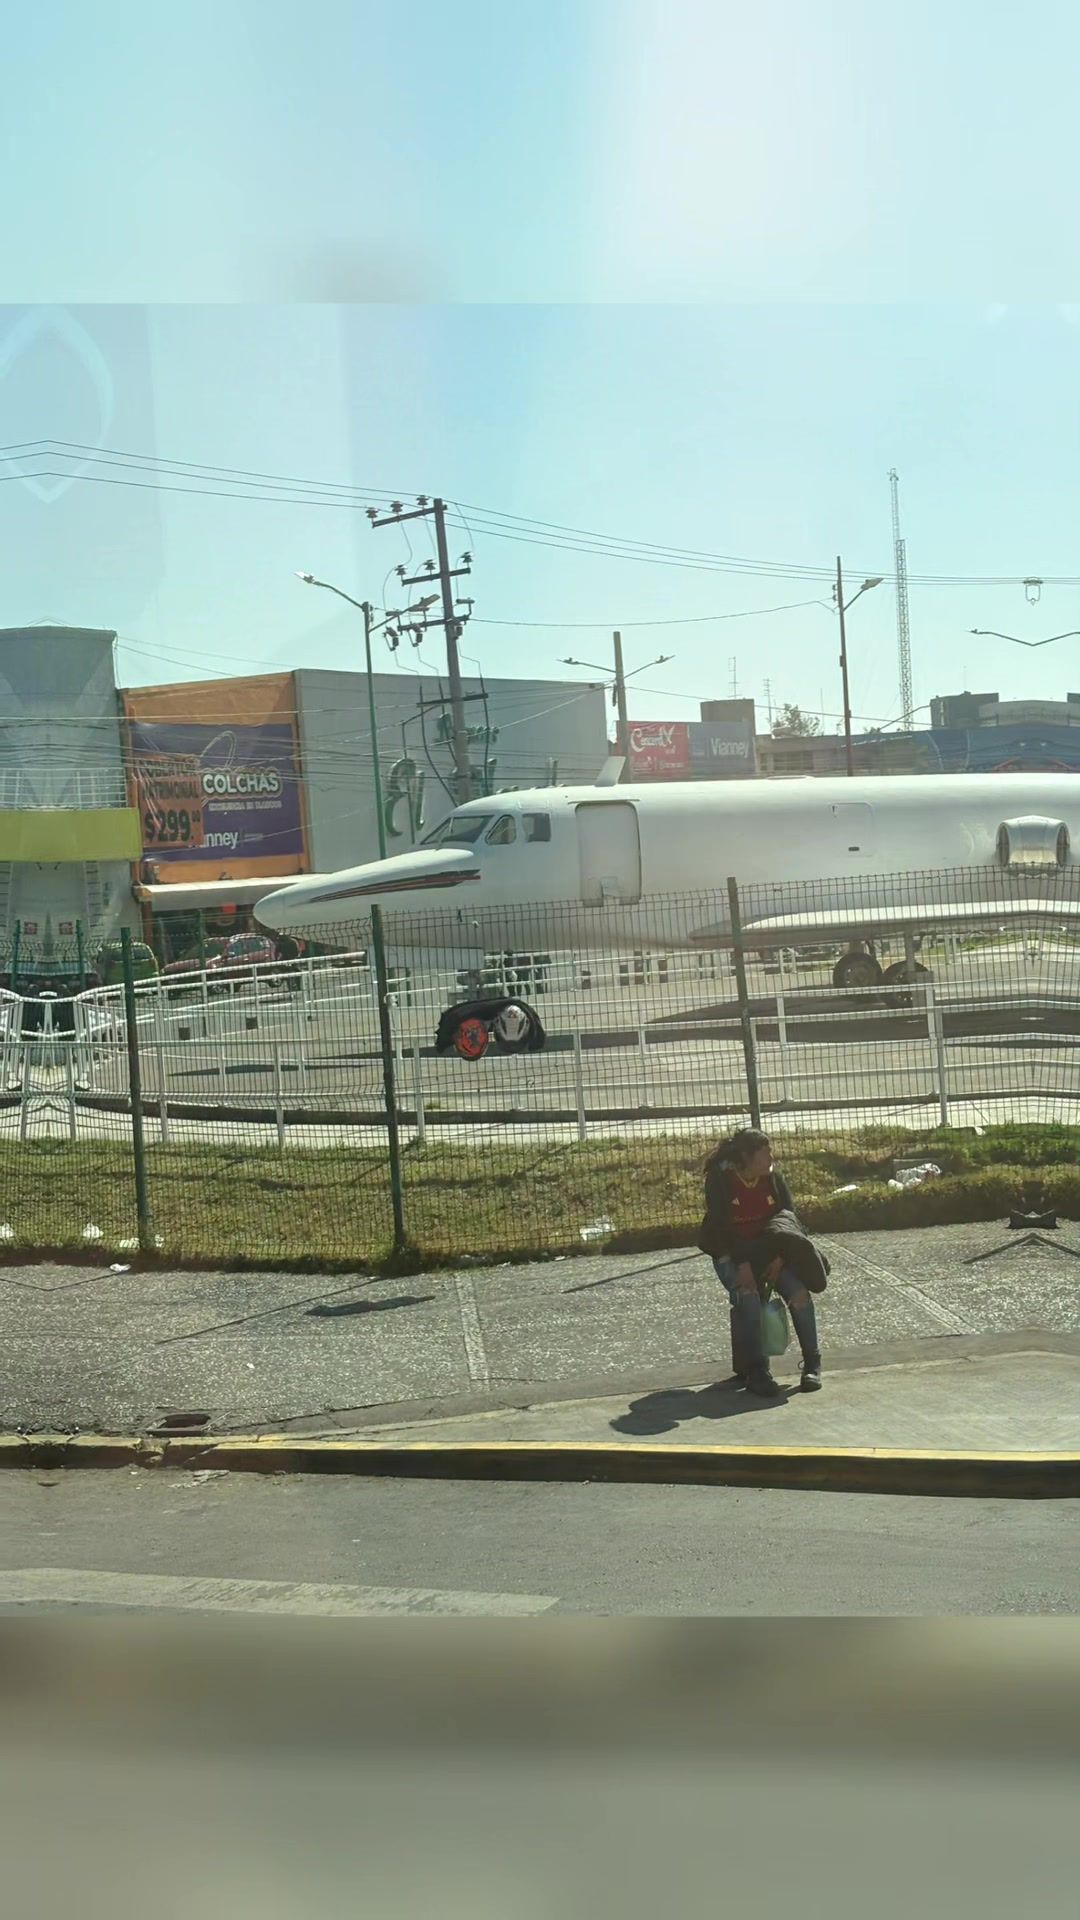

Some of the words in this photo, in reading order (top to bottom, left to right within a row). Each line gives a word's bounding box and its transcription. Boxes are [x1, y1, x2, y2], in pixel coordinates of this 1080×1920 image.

[710, 737, 749, 759] Vianney
[202, 772, 279, 794] COLCHAS
[189, 831, 238, 849] nney
